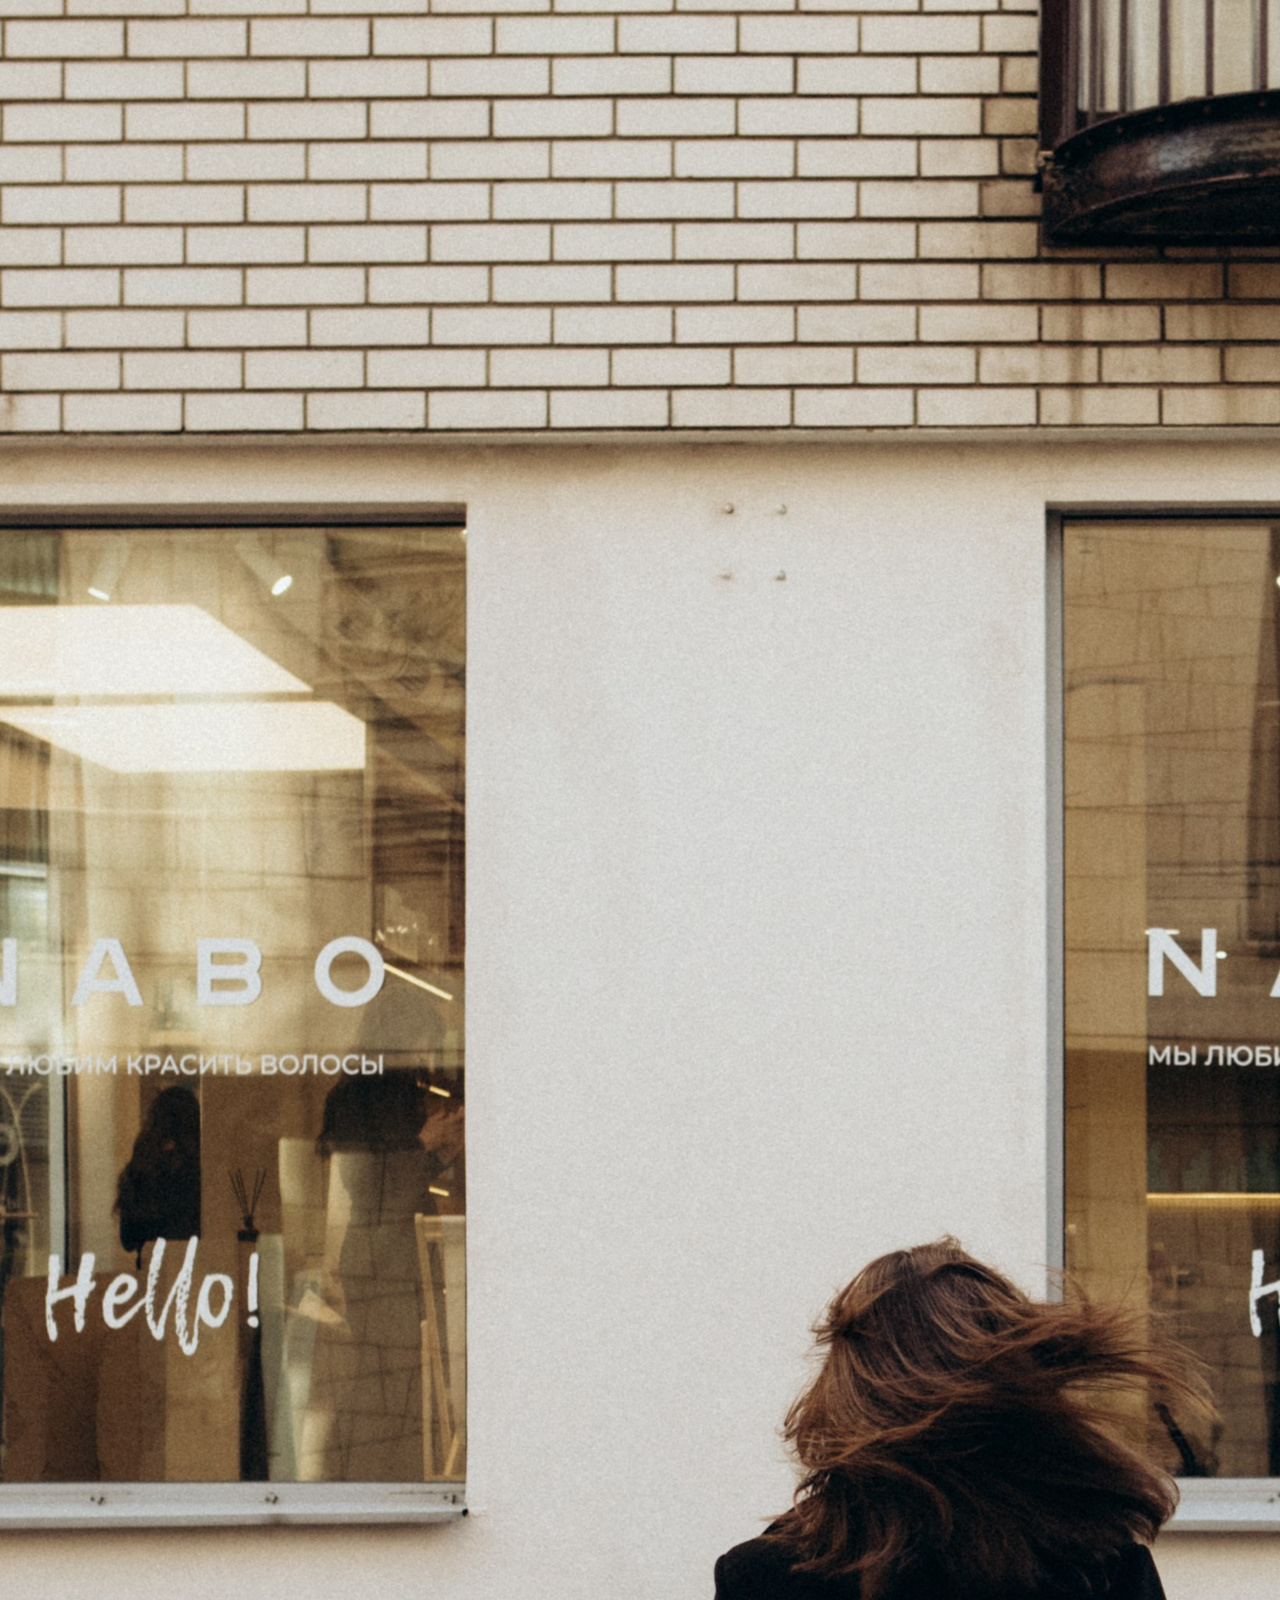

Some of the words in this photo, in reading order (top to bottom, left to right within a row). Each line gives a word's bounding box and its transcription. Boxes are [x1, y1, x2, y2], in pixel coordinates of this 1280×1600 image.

[0, 936, 386, 1007] ABO
[5, 1054, 118, 1076] ЛЮБИМ
[126, 1054, 252, 1076] КРАСИТЬ
[260, 1054, 385, 1076] ВОЛОСЫ
[1148, 1045, 1197, 1066] МЫ
[45, 1235, 260, 1356] Hello!
